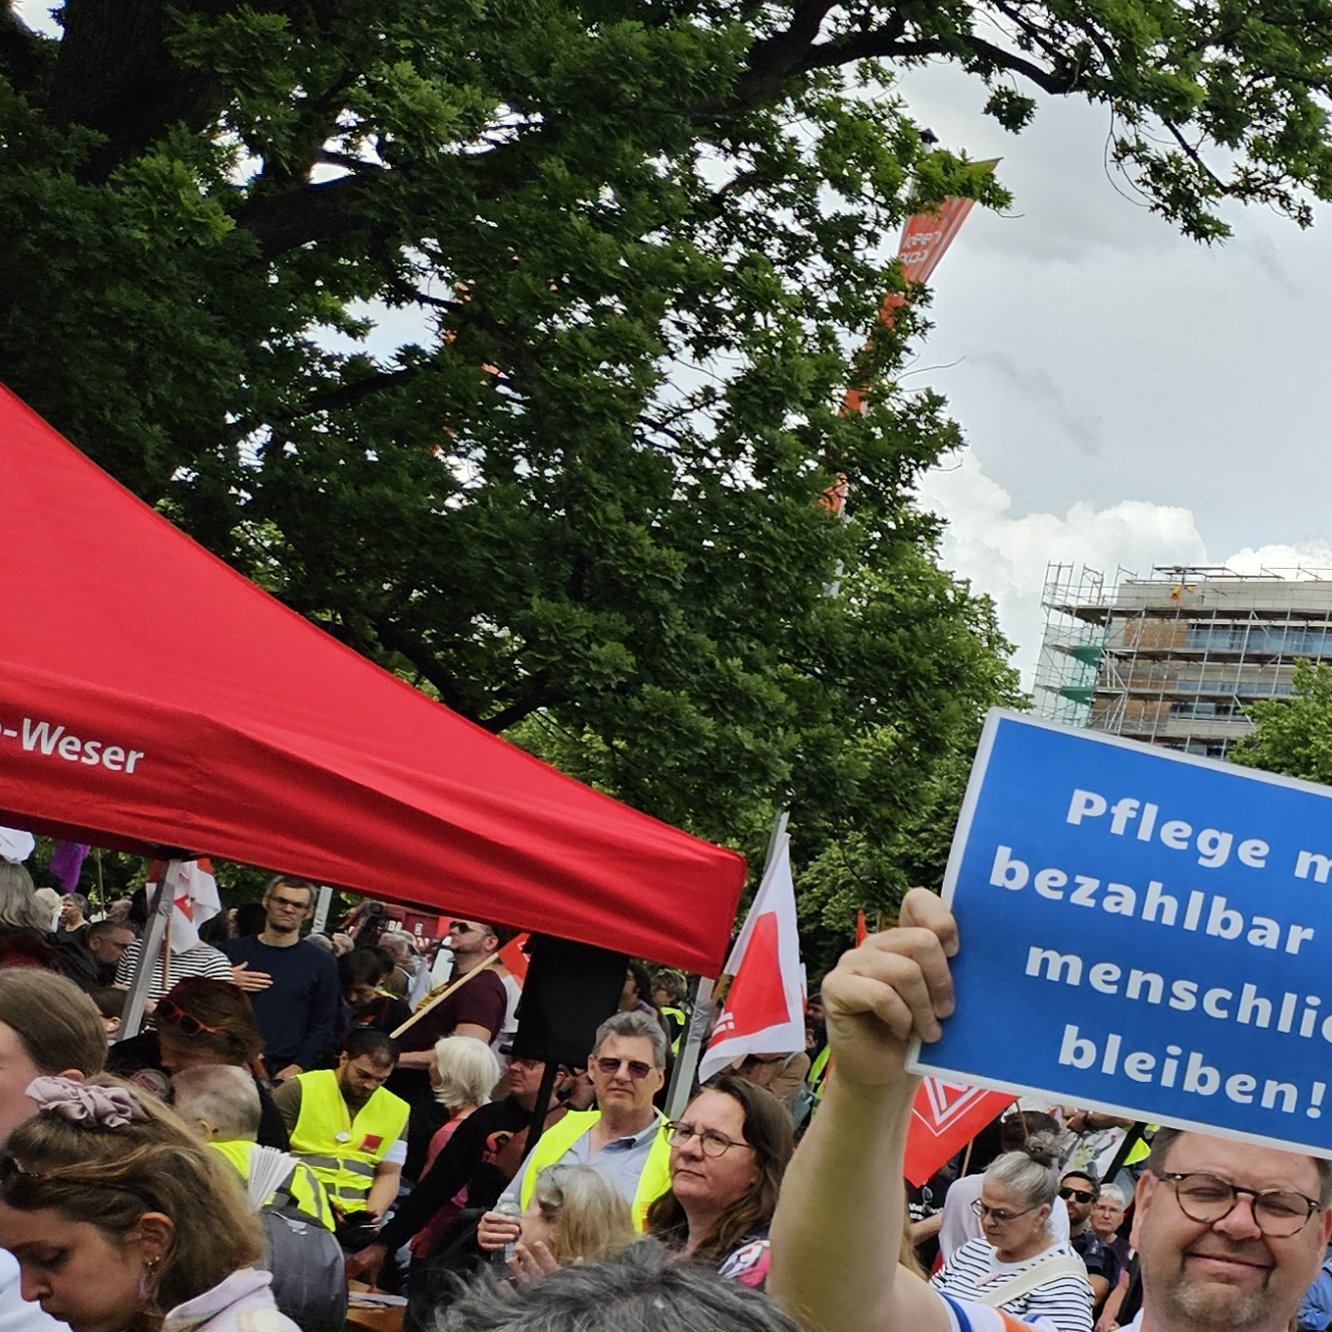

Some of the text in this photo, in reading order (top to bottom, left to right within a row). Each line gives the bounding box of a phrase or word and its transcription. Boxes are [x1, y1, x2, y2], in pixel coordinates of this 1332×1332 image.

[0, 717, 145, 774] -Weser
[1065, 788, 1272, 870] Pflege
[988, 845, 1316, 956] bezahlbar
[1058, 1023, 1328, 1120] bleiben!
